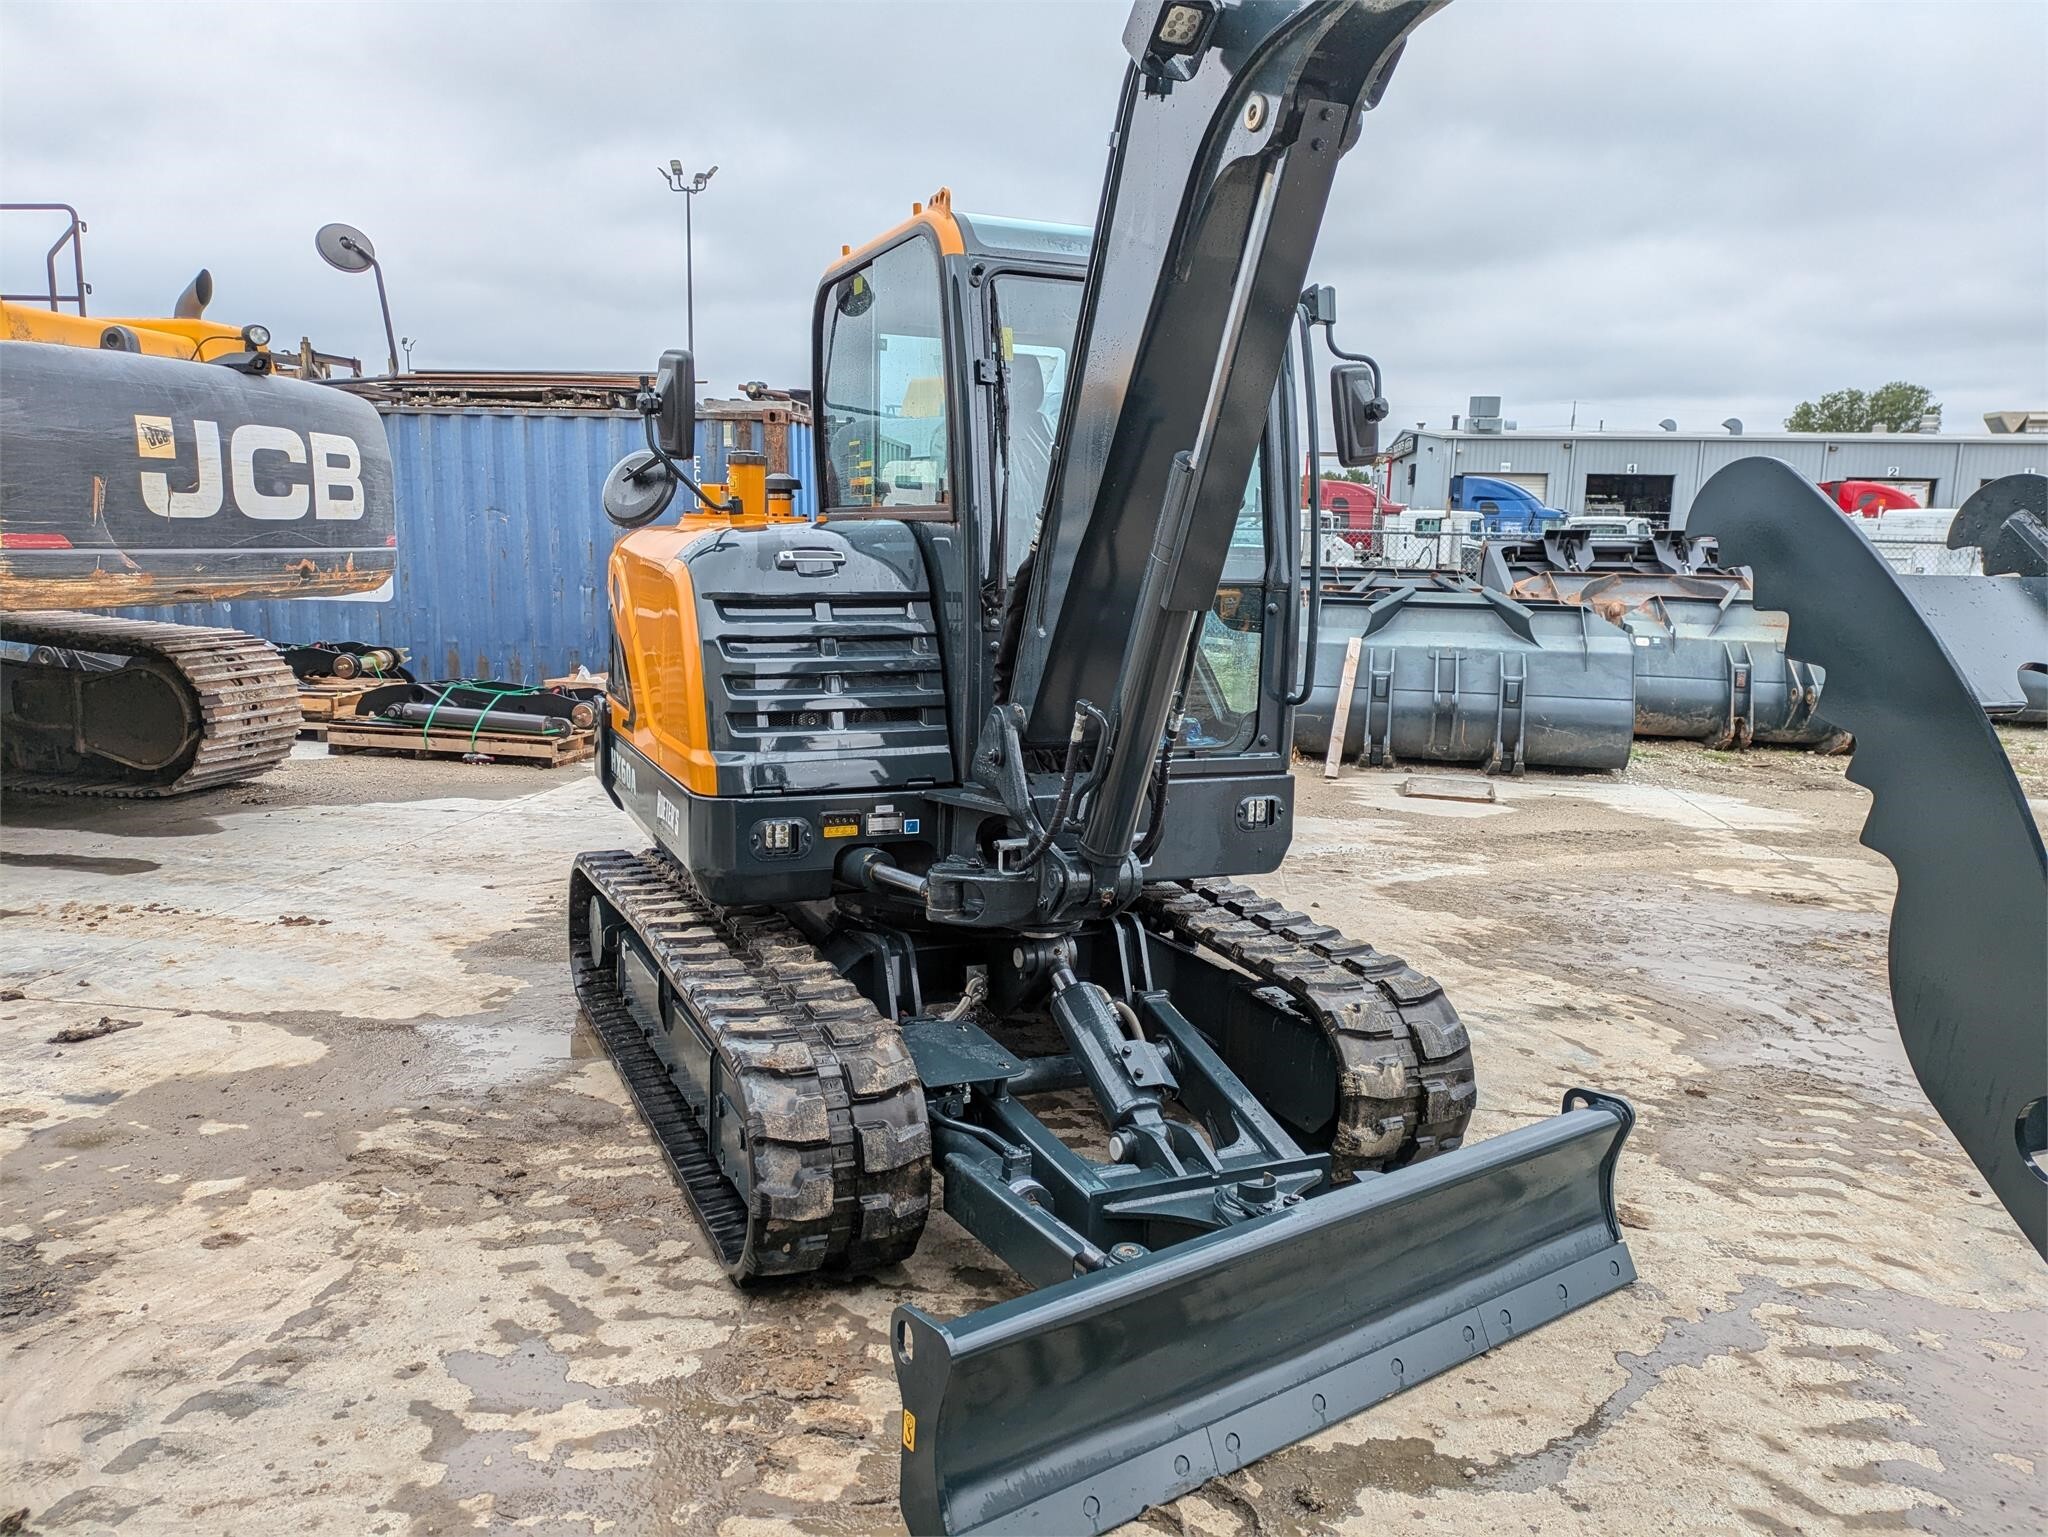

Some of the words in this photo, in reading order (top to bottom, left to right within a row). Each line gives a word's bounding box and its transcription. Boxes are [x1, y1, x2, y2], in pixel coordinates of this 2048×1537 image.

[146, 426, 169, 446] JCB
[141, 420, 365, 520] JCB
[1628, 464, 1635, 473] 4
[1889, 467, 1897, 477] 2
[610, 746, 637, 796] HX60A
